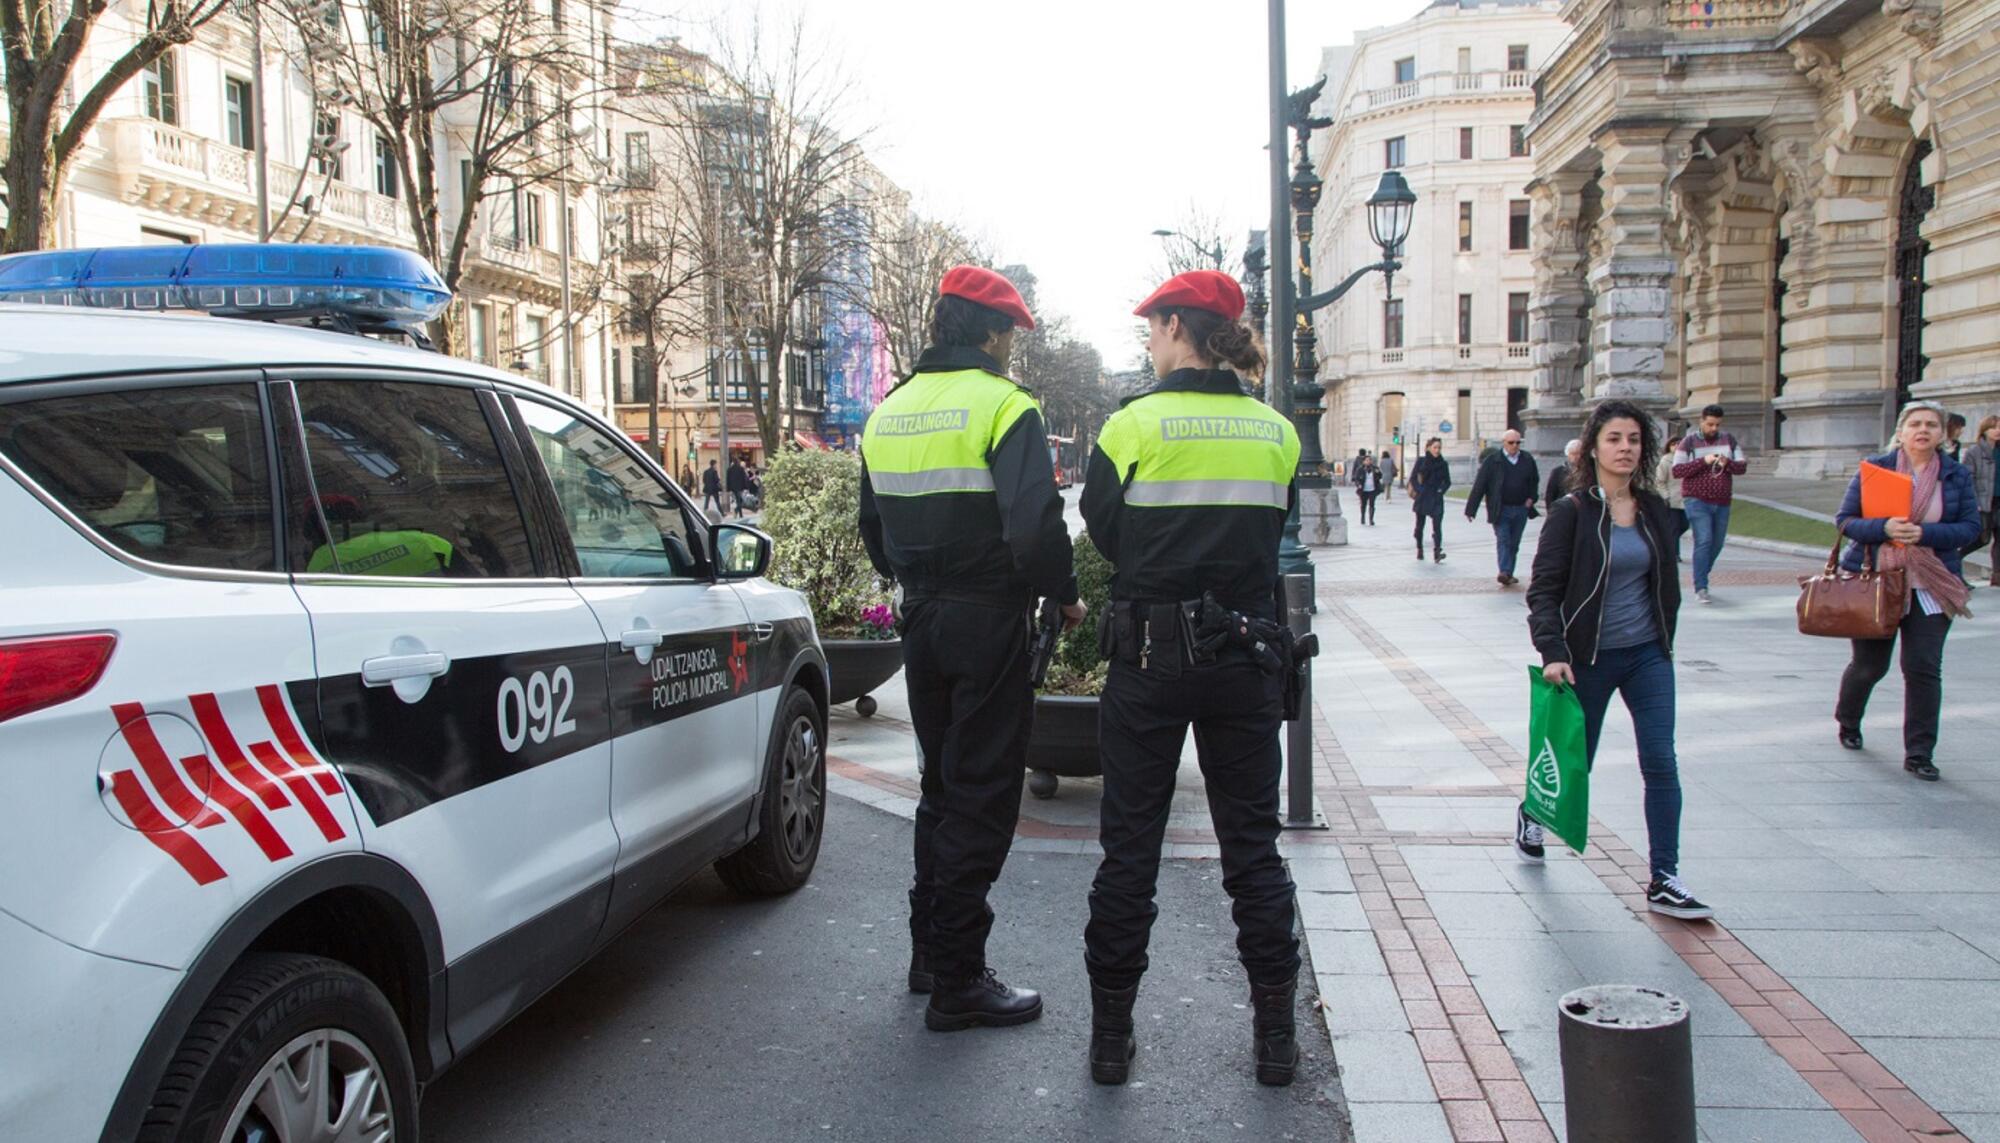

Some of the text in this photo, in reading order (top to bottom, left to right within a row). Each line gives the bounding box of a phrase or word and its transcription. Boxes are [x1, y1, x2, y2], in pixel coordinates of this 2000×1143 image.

[878, 411, 963, 434] UDALTZAINGOA
[1165, 418, 1281, 440] UDALTZAINGOA
[651, 648, 718, 682] UDALTZAINGOA
[653, 670, 728, 710] POLICIA MUNICIPAL
[497, 665, 576, 753] 092
